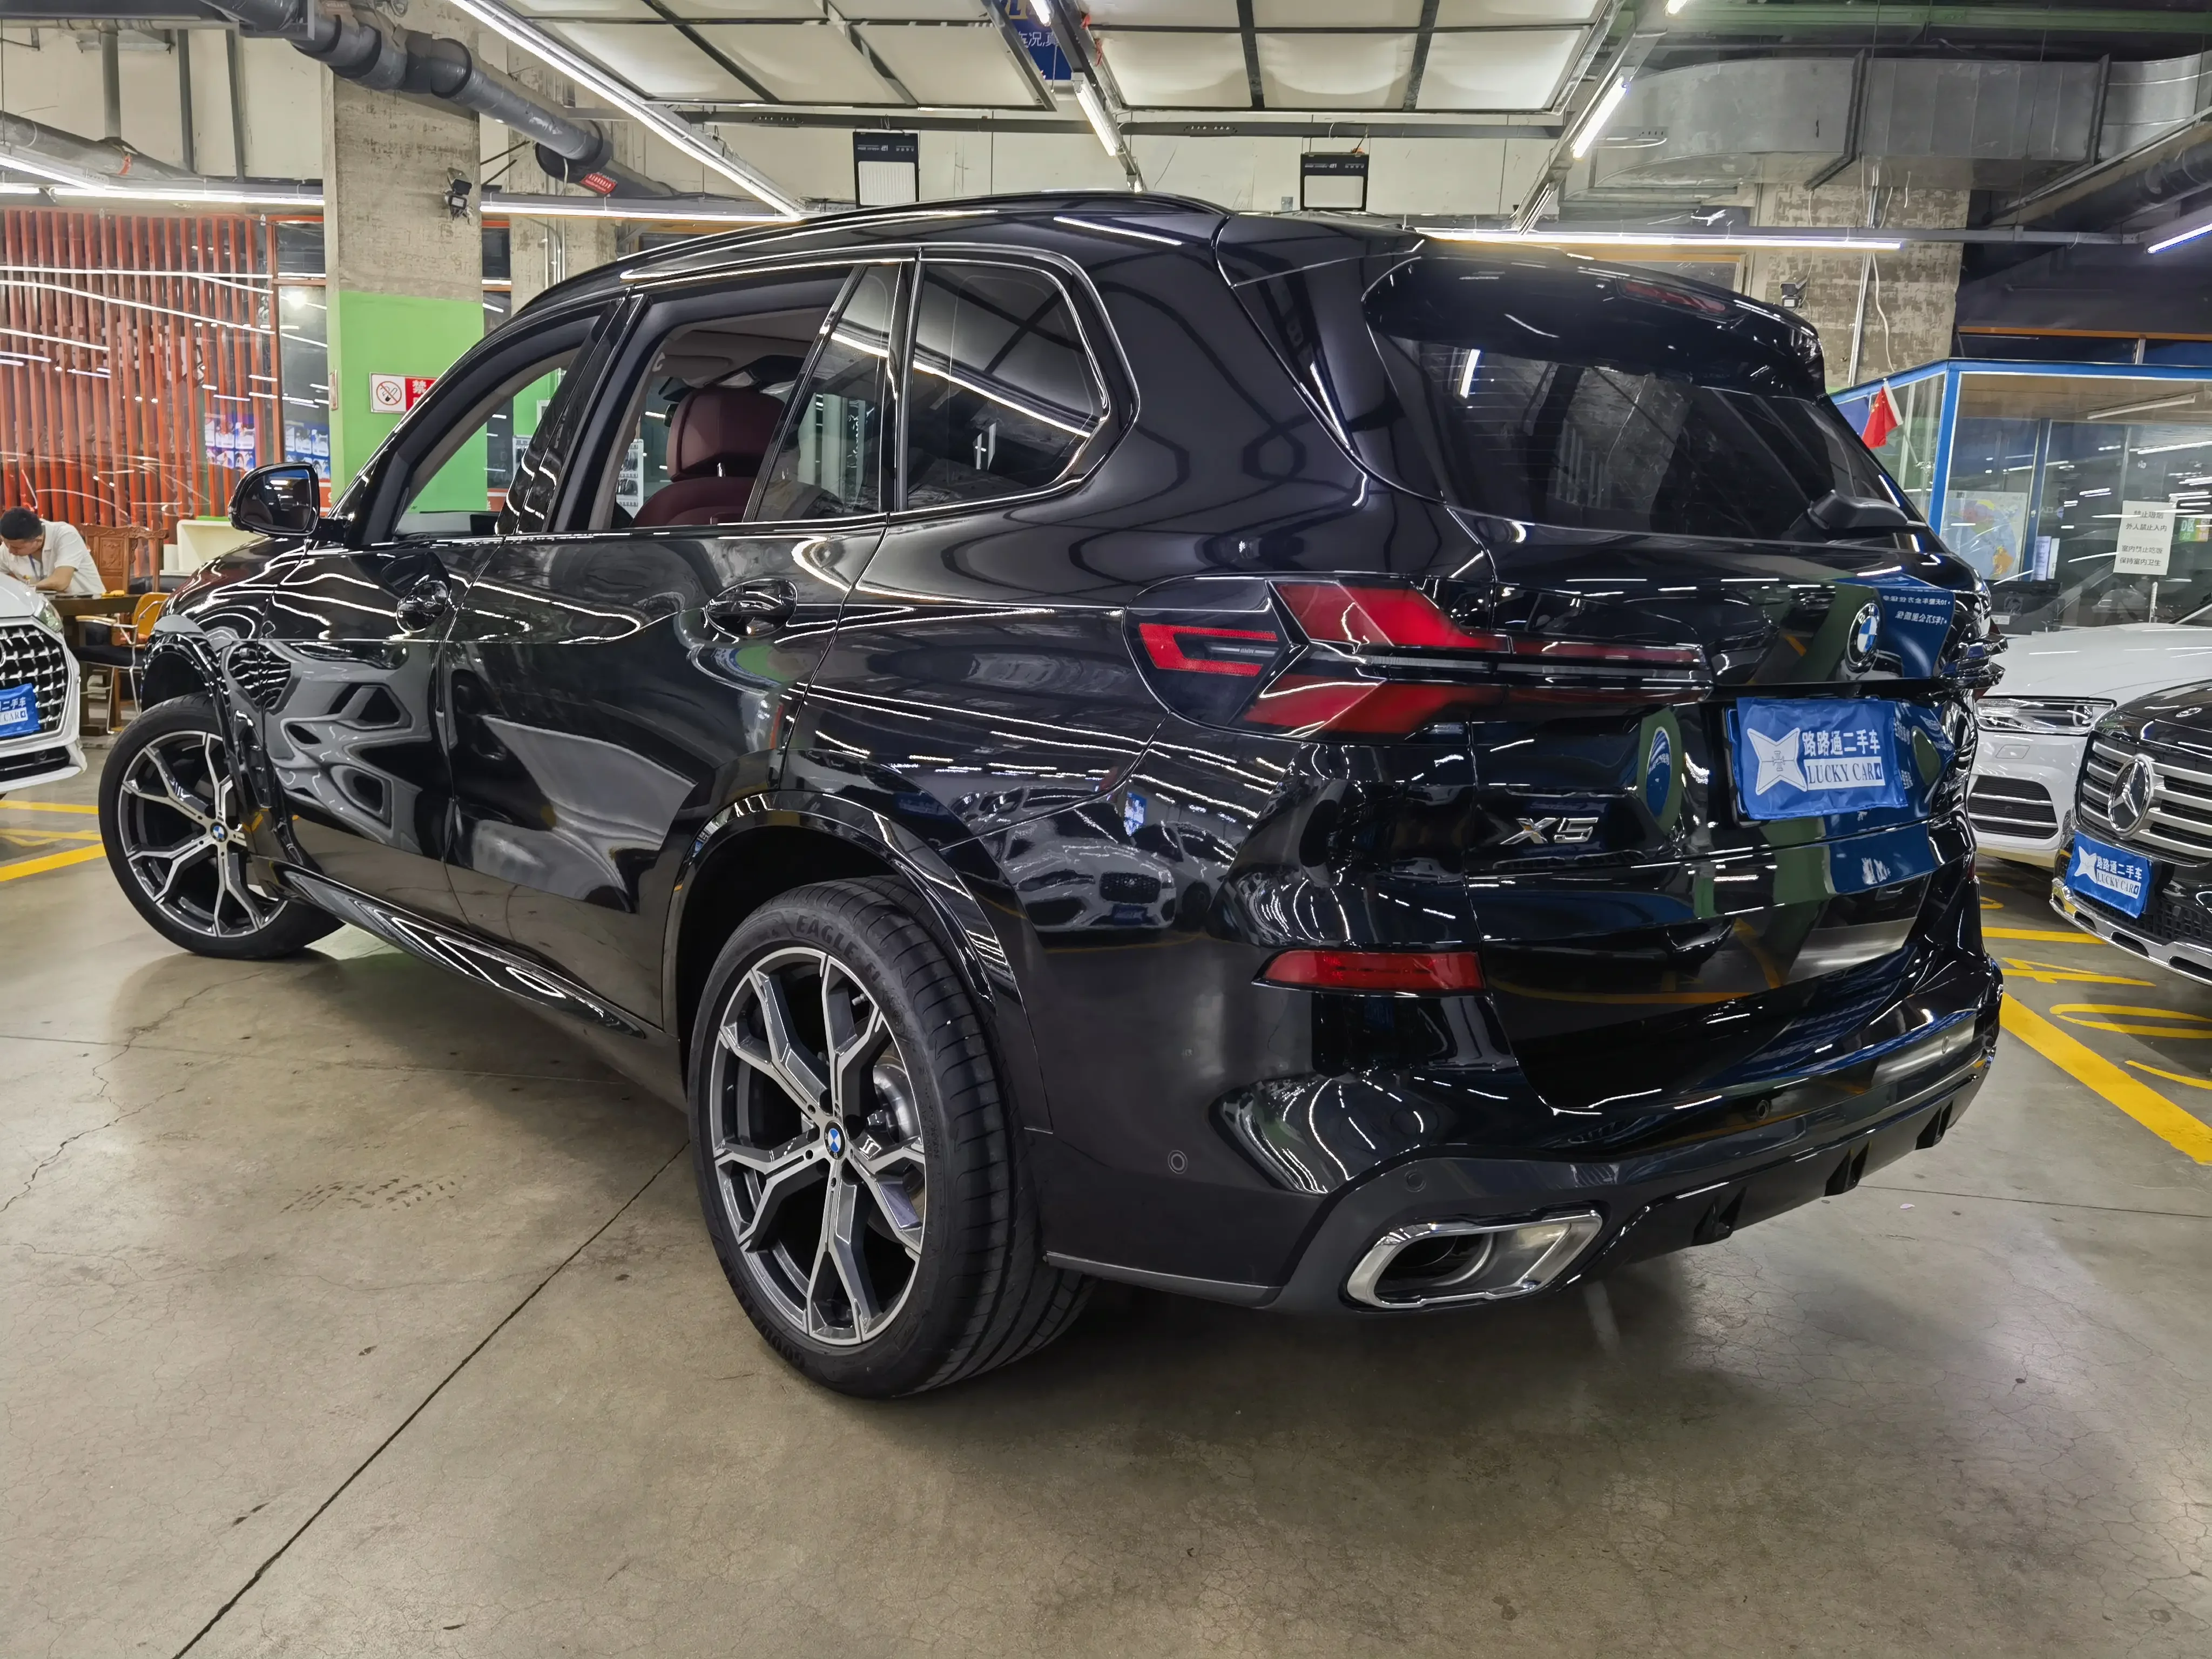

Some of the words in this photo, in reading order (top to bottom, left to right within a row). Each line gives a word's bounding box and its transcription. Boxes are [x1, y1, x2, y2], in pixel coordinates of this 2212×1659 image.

[2126, 523, 2167, 532] 外人禁止入内
[2120, 557, 2161, 567] 保持室内卫生
[0, 697, 26, 711] 二手车
[1802, 729, 1880, 757] 路路通二手车
[1807, 764, 1849, 784] LUCKY
[1499, 817, 1599, 845] X5
[2096, 856, 2142, 881] 路路通二手车
[2097, 872, 2119, 888] LUCKY
[796, 915, 859, 961] EAGLE
